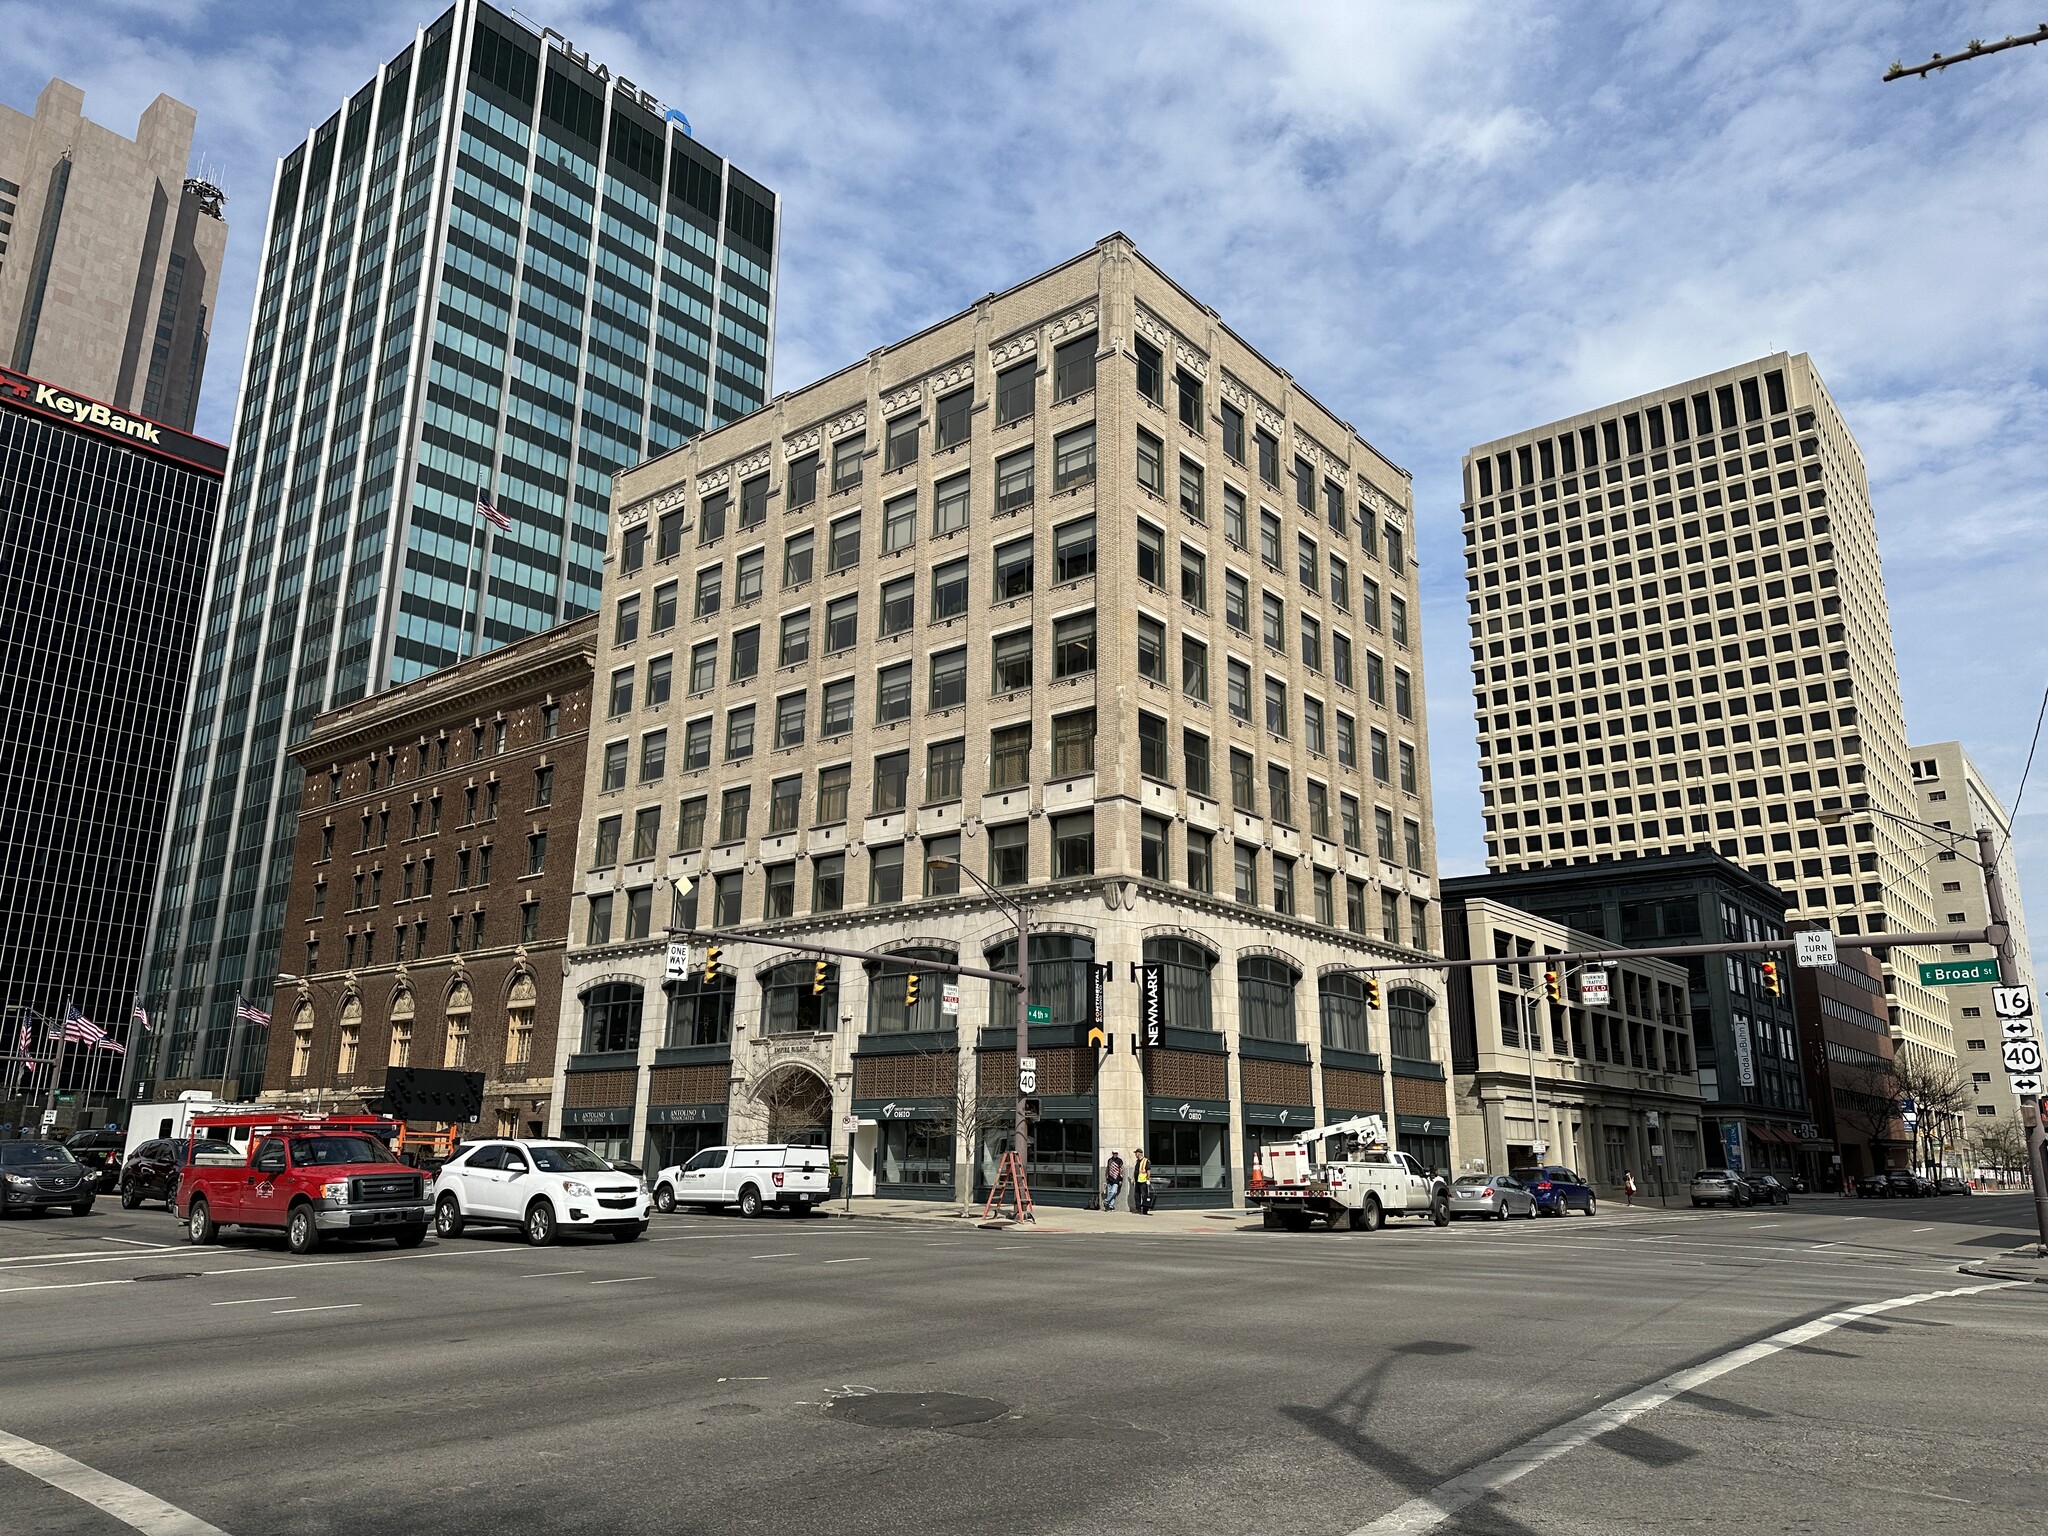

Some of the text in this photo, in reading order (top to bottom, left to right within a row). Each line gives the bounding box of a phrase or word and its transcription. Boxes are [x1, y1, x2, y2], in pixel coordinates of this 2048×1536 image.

[35, 383, 161, 445] KeyBank
[1807, 935, 1821, 943] NO
[671, 946, 686, 955] ONE
[1804, 944, 1827, 952] TURN
[670, 956, 686, 965] WAY
[1934, 966, 1980, 980] Broad
[1147, 968, 1159, 1046] NEWMARK
[2000, 992, 2025, 1009] 16
[1032, 1010, 1044, 1019] 4th
[2006, 1047, 2035, 1065] 40
[1022, 1060, 1034, 1068] WEST
[1021, 1075, 1034, 1089] 40
[1801, 1123, 1819, 1139] 35
